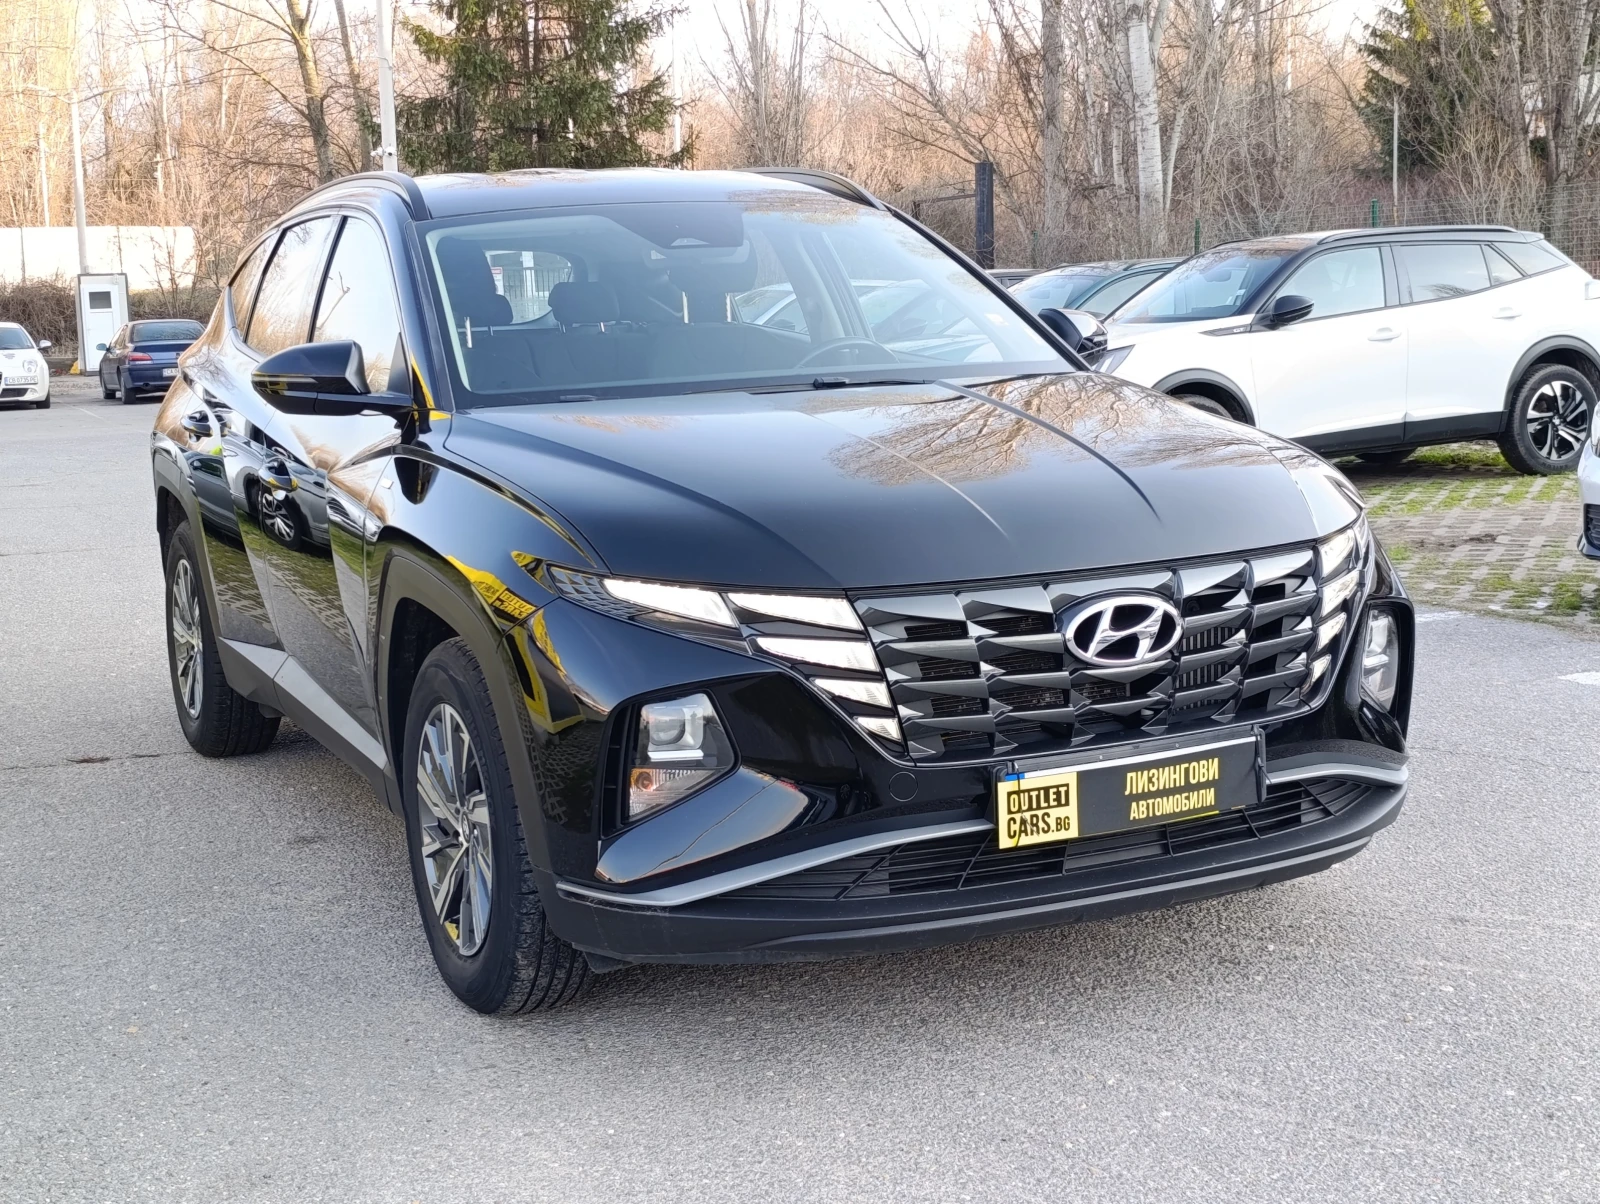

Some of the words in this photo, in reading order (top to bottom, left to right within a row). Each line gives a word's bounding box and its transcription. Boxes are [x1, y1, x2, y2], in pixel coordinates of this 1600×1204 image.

[1124, 757, 1219, 796] ЛИЗИНГОВИ
[1009, 786, 1068, 812] OUTLET
[1129, 787, 1215, 821] АВТОМОБИЛИ
[1007, 812, 1071, 840] CARS.BG
